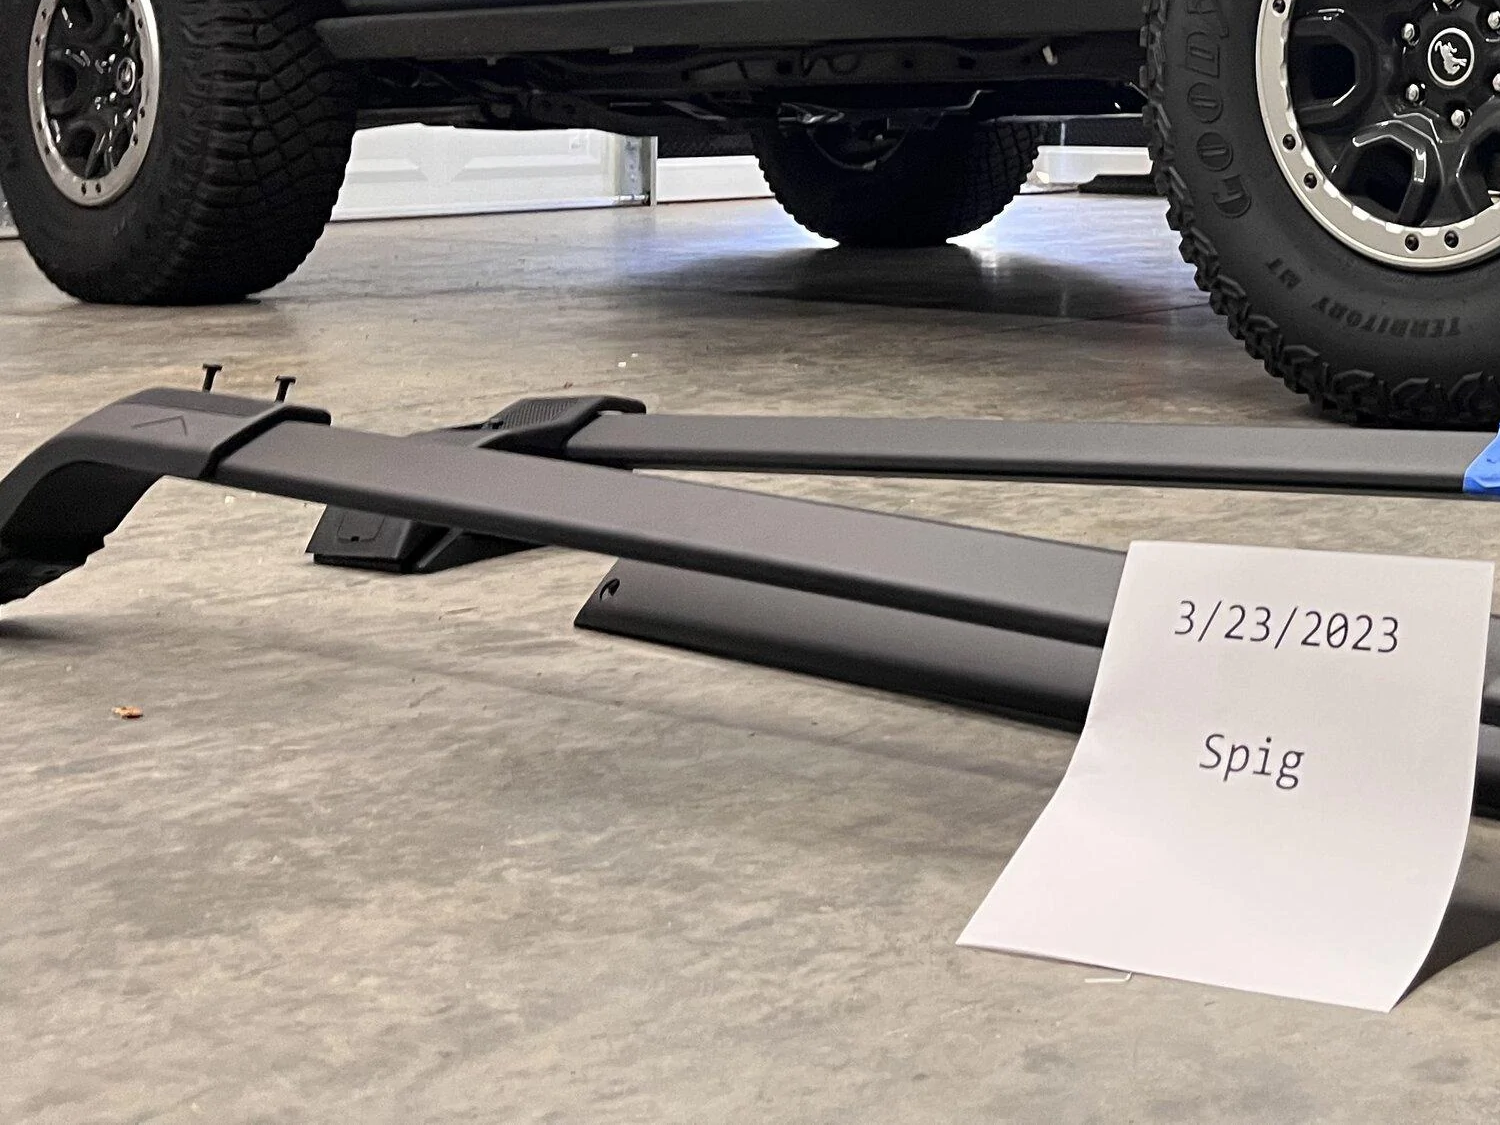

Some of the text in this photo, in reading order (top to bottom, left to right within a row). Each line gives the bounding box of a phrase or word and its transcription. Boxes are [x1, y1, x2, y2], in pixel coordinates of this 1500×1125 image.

[1312, 296, 1461, 338] TERRITORY
[1174, 600, 1399, 653] 3/23/2023
[1199, 733, 1305, 790] Spig
